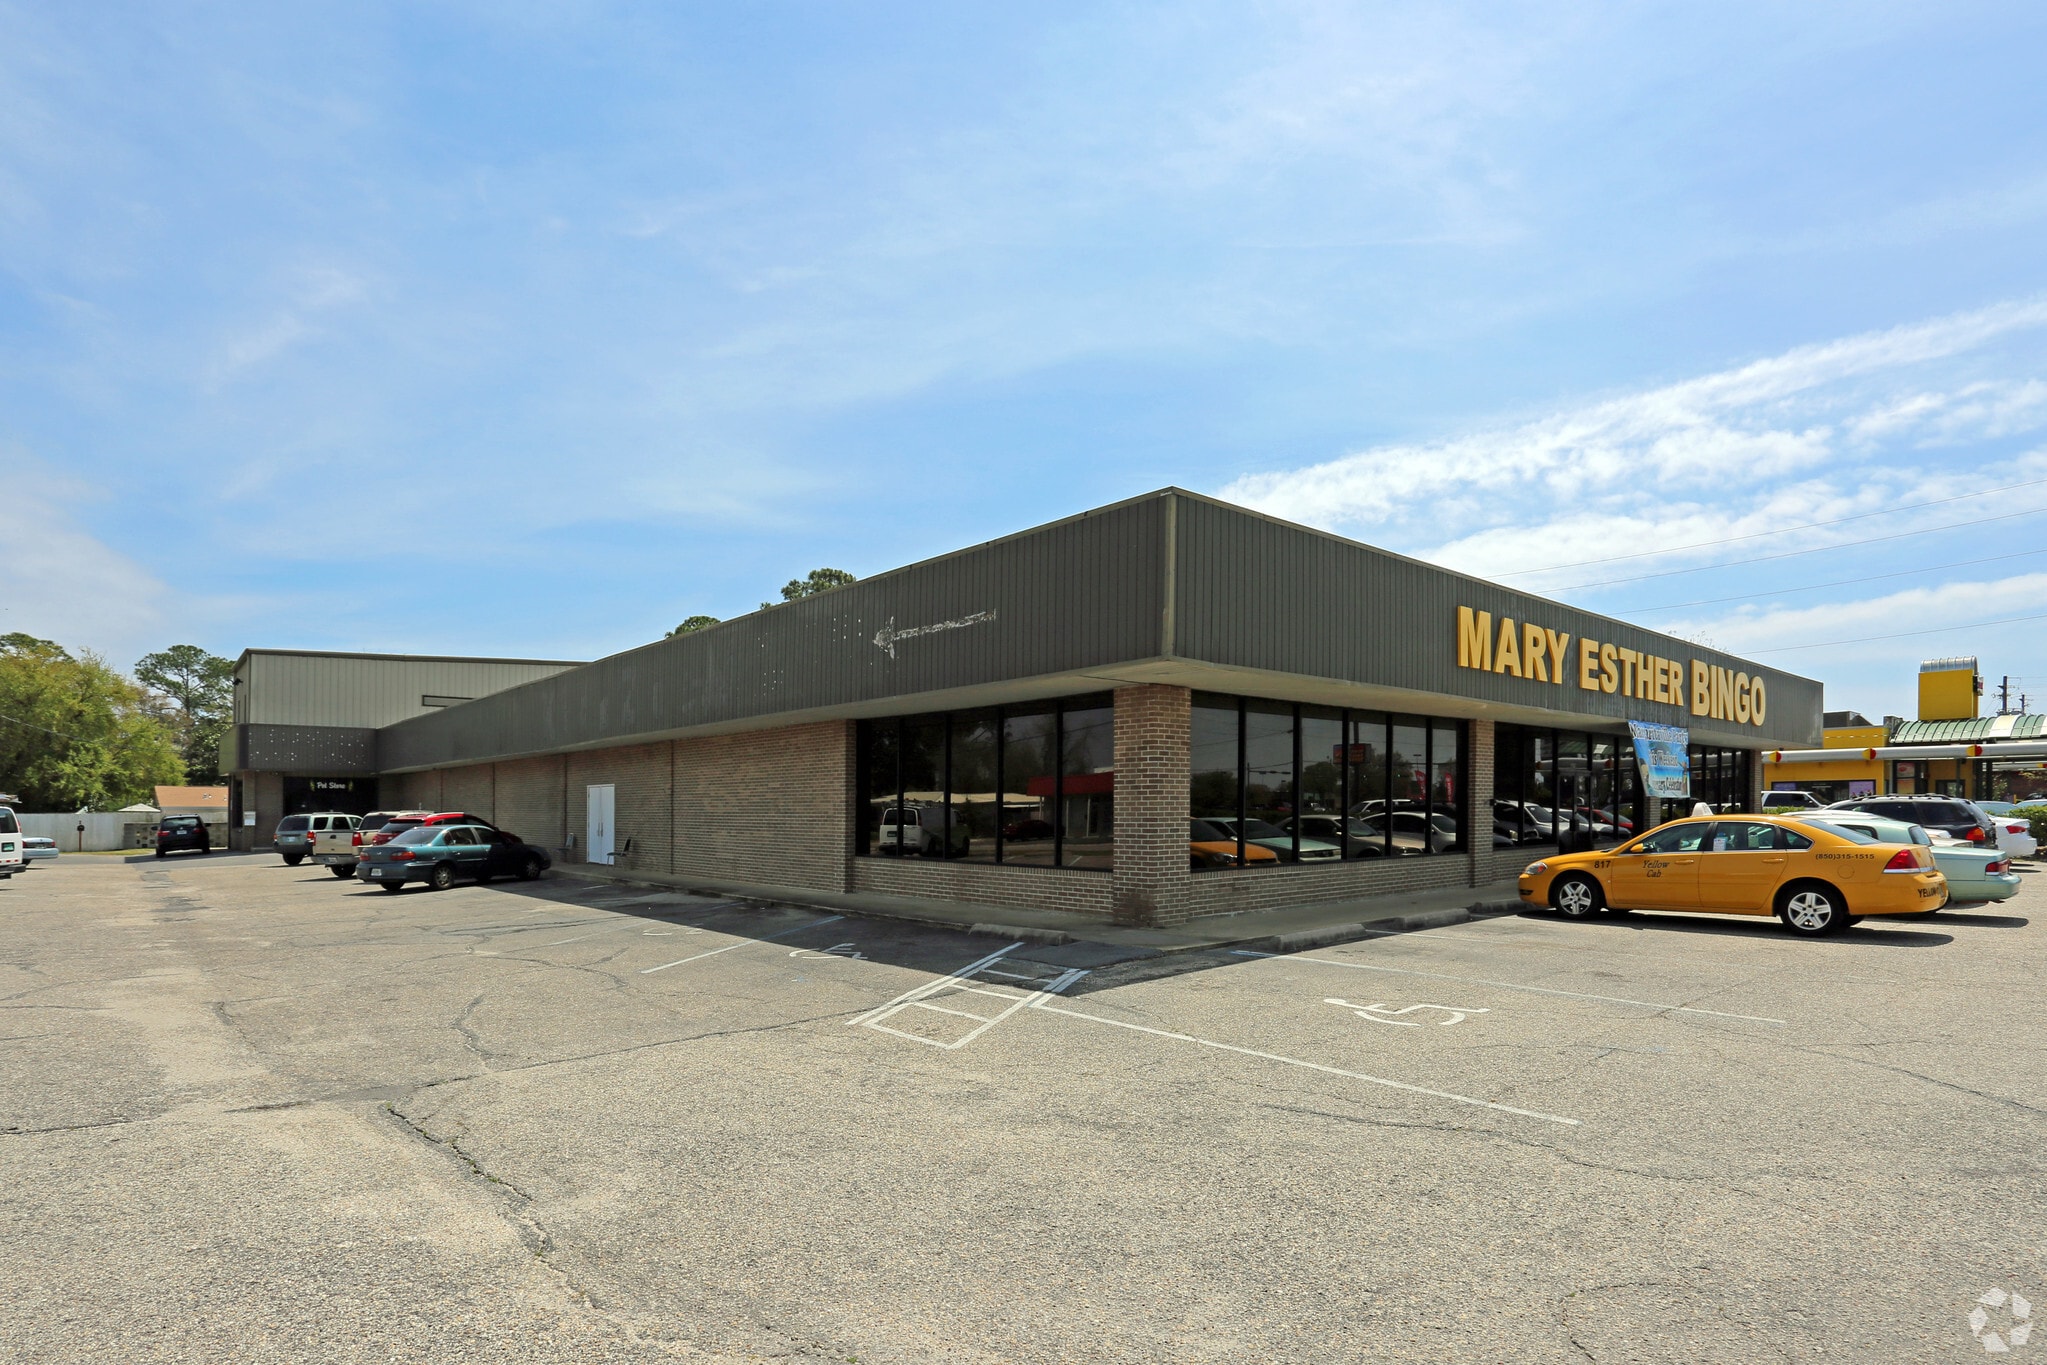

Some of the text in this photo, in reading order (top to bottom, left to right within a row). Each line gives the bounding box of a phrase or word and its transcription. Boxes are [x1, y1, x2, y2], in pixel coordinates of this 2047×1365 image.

[1458, 606, 1766, 727] MARY ESTHER BINGO
[1594, 860, 1611, 868] 817
[1642, 860, 1669, 868] Yellow
